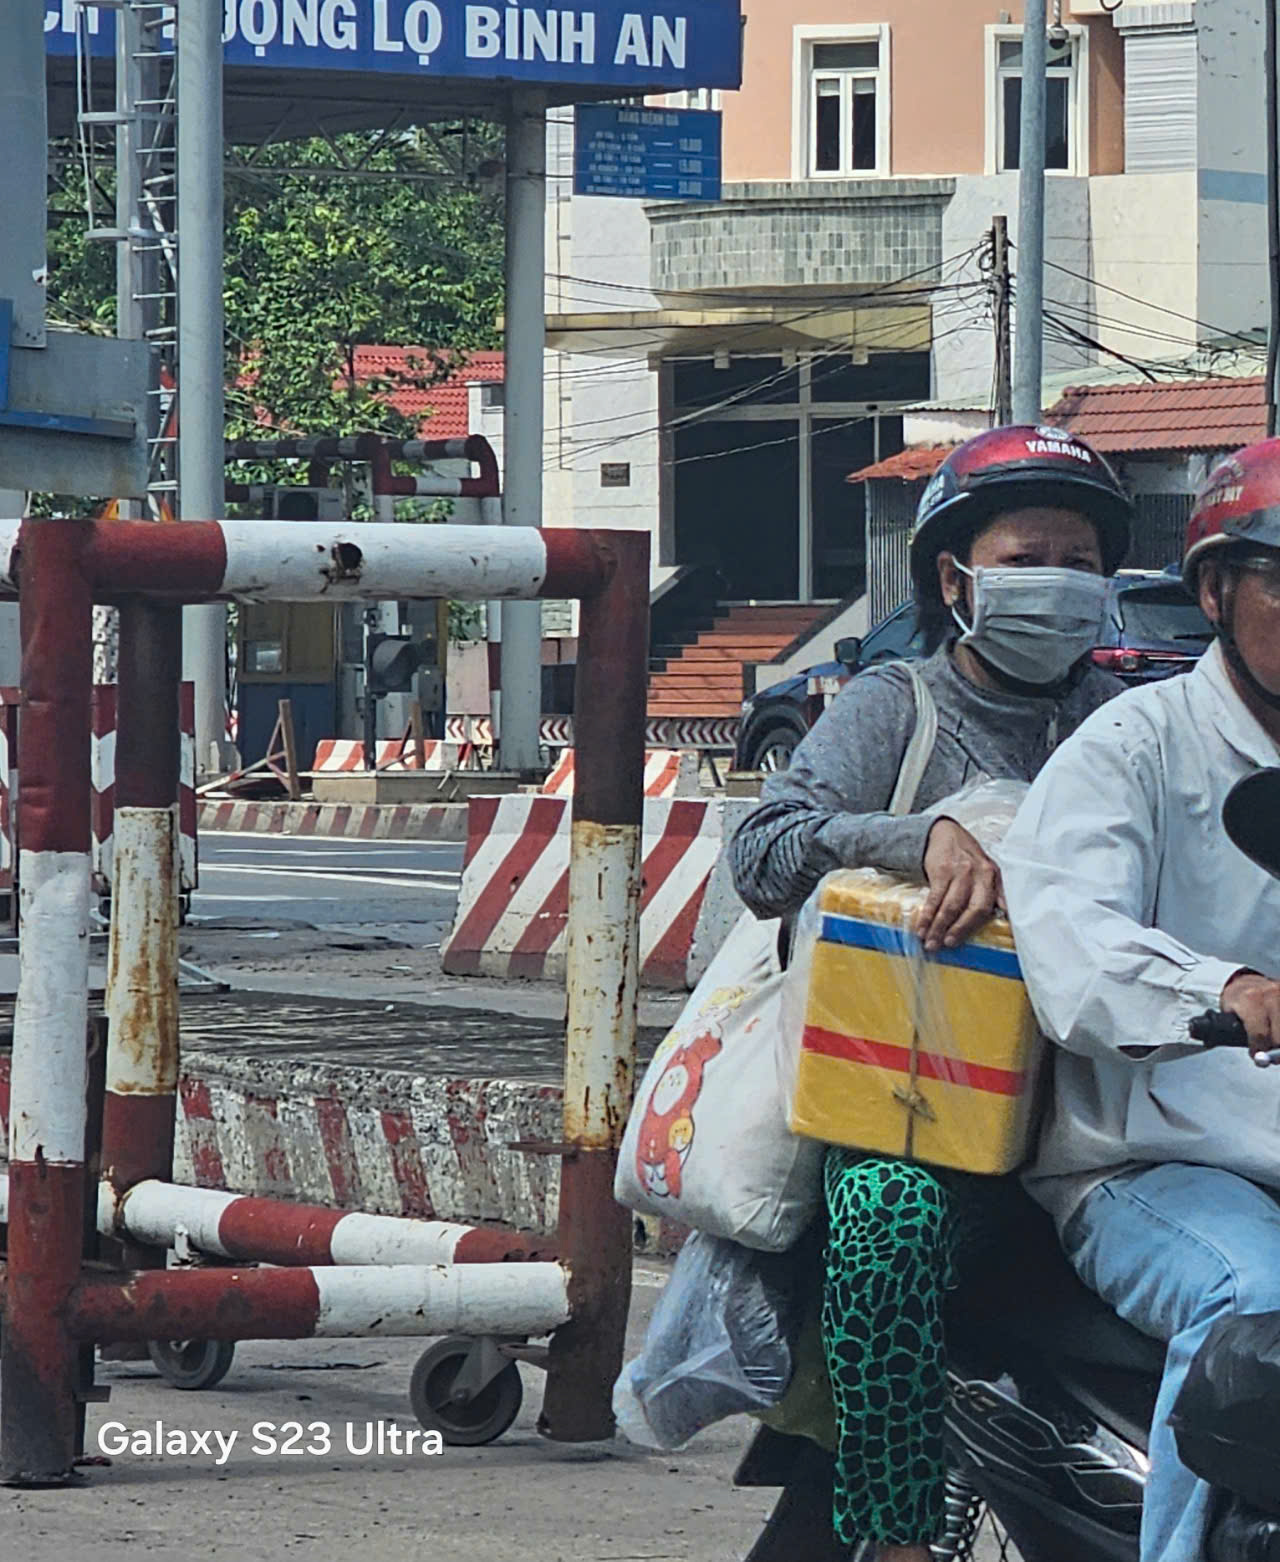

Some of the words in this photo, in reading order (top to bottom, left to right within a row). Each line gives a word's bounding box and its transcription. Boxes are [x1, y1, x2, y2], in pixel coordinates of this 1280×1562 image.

[465, 0, 596, 64] BÌNH
[614, 13, 687, 69] AN
[1025, 440, 1091, 463] YAMAHA
